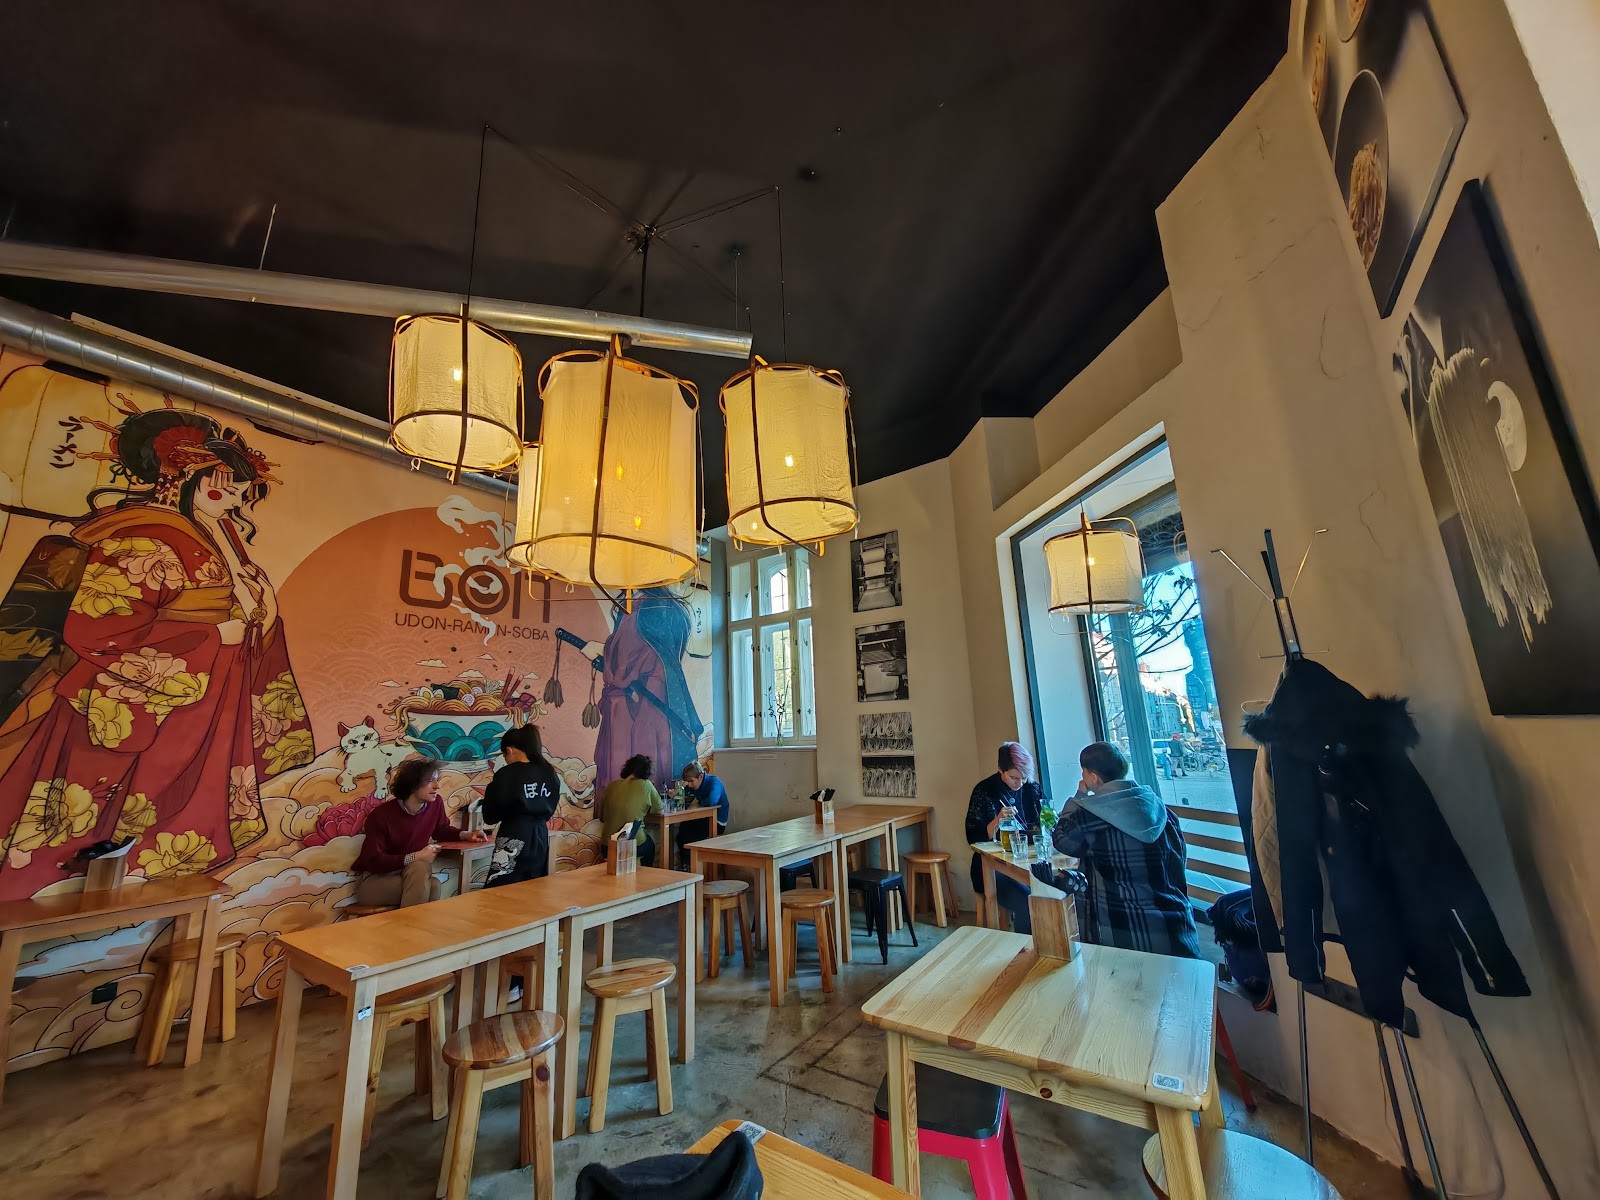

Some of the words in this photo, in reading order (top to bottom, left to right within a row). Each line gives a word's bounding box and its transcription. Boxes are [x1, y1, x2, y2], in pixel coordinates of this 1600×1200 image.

[50, 416, 83, 468] ラーメン
[395, 612, 550, 641] UDON-RAMN-SOBA
